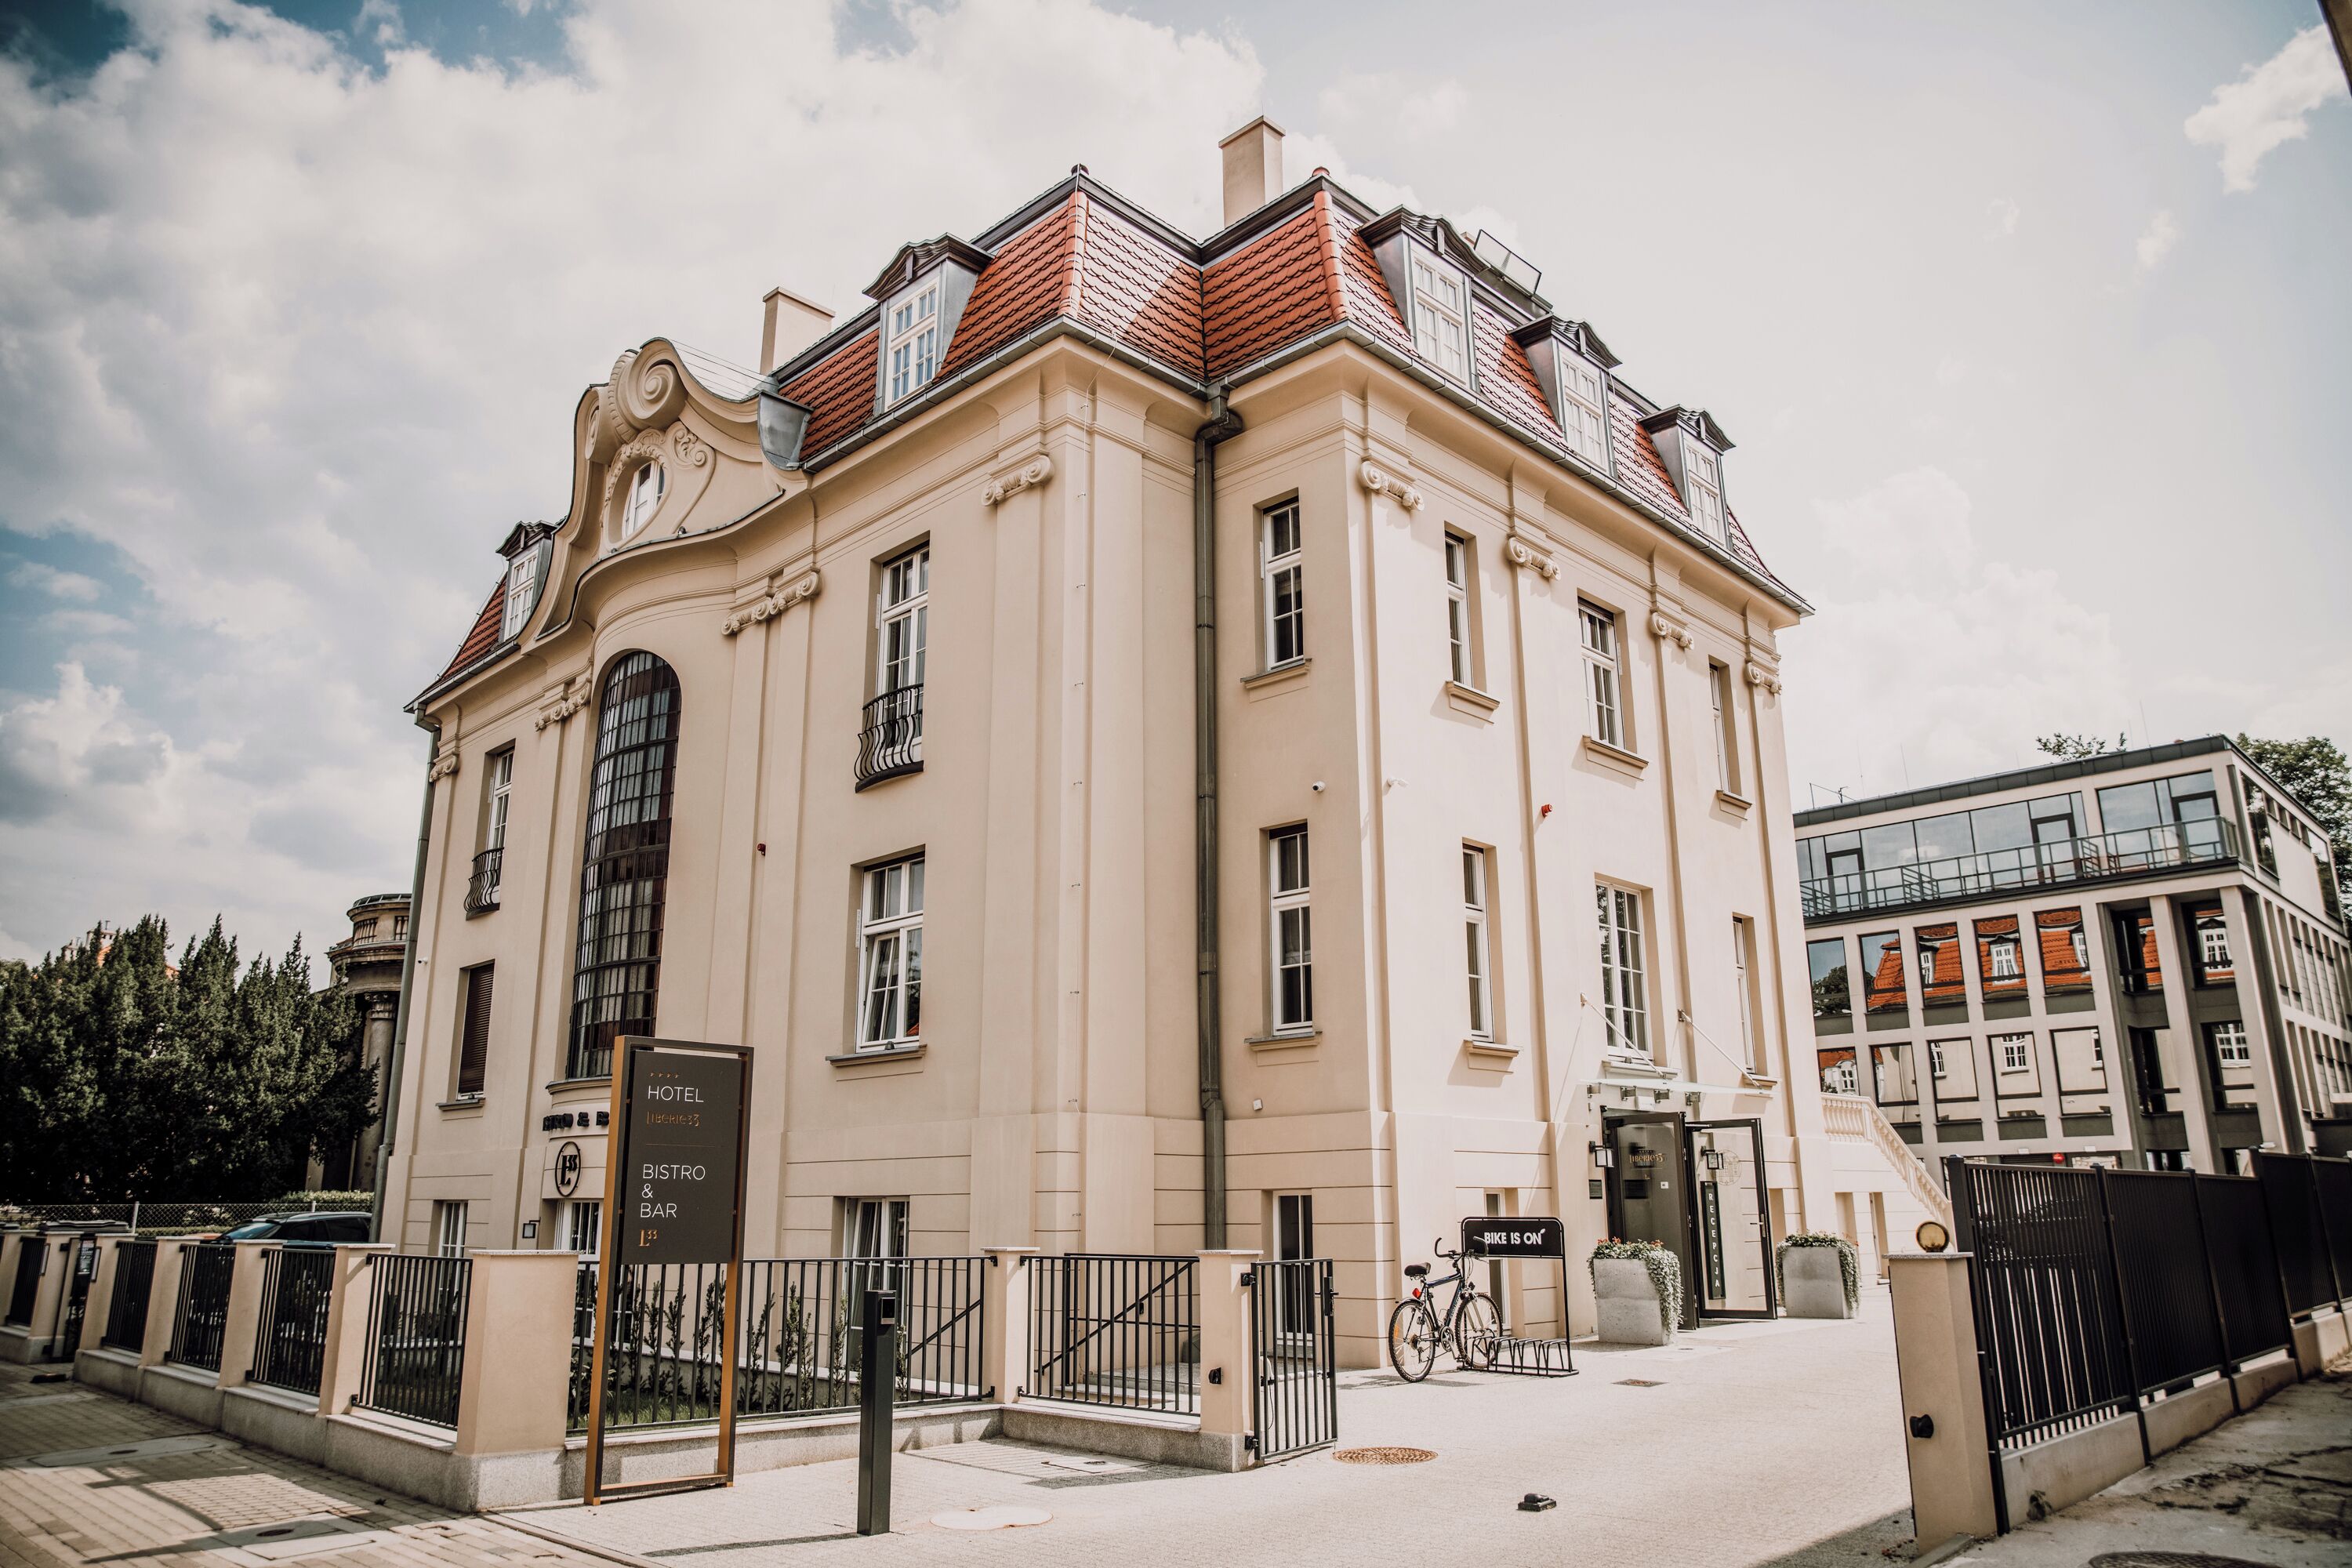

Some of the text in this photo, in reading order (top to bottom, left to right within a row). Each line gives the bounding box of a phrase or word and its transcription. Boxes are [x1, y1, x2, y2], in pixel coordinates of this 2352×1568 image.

[648, 1085, 704, 1102] HOTEL
[643, 1163, 706, 1181] BISTRO
[641, 1183, 653, 1198] &
[640, 1203, 677, 1218] BAR
[1483, 1232, 1542, 1245] BIKE IS ON
[1708, 1193, 1720, 1287] RECEPCJA
